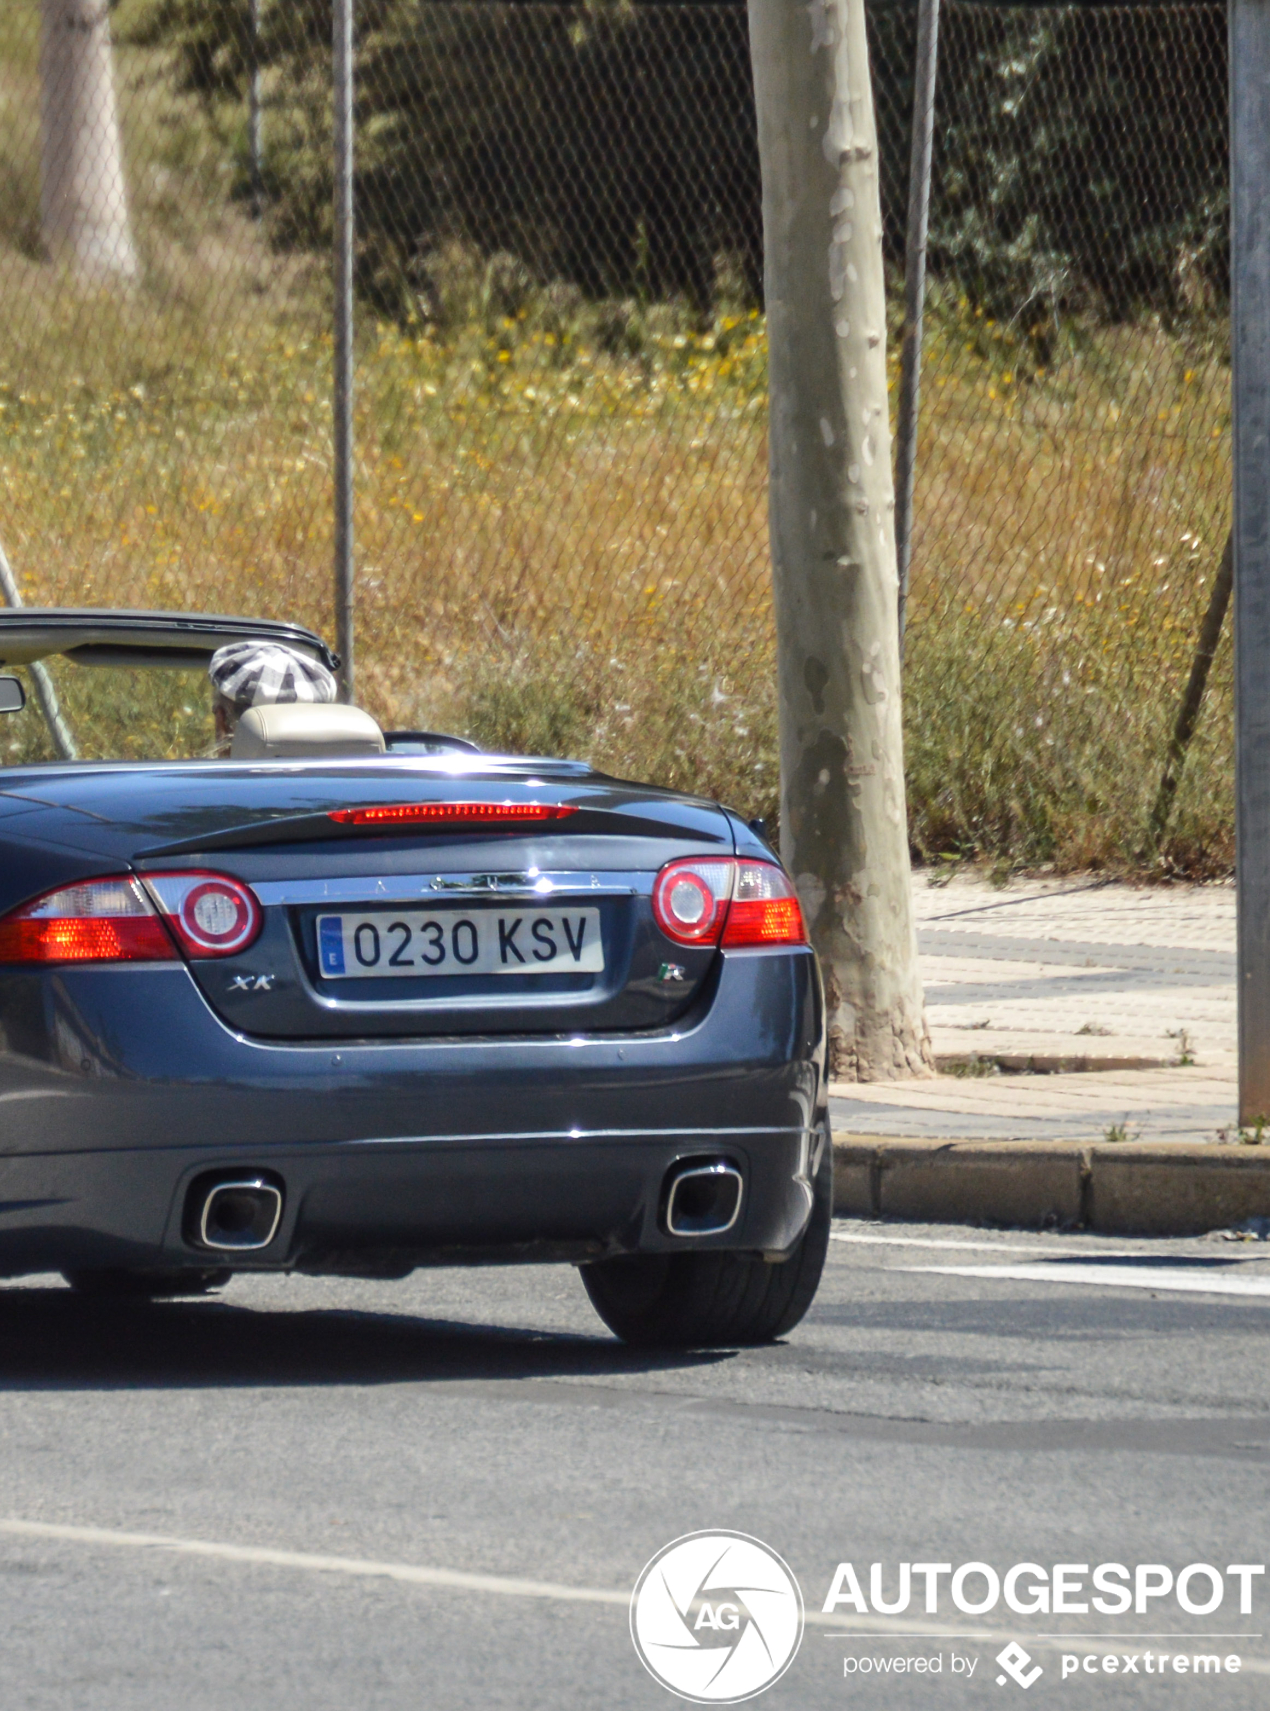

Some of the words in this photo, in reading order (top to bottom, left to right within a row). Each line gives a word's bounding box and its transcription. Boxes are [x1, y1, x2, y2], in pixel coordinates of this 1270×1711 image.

[353, 919, 479, 967] 0230
[497, 917, 587, 964] KSV
[328, 952, 338, 966] E
[227, 973, 276, 991] XK
